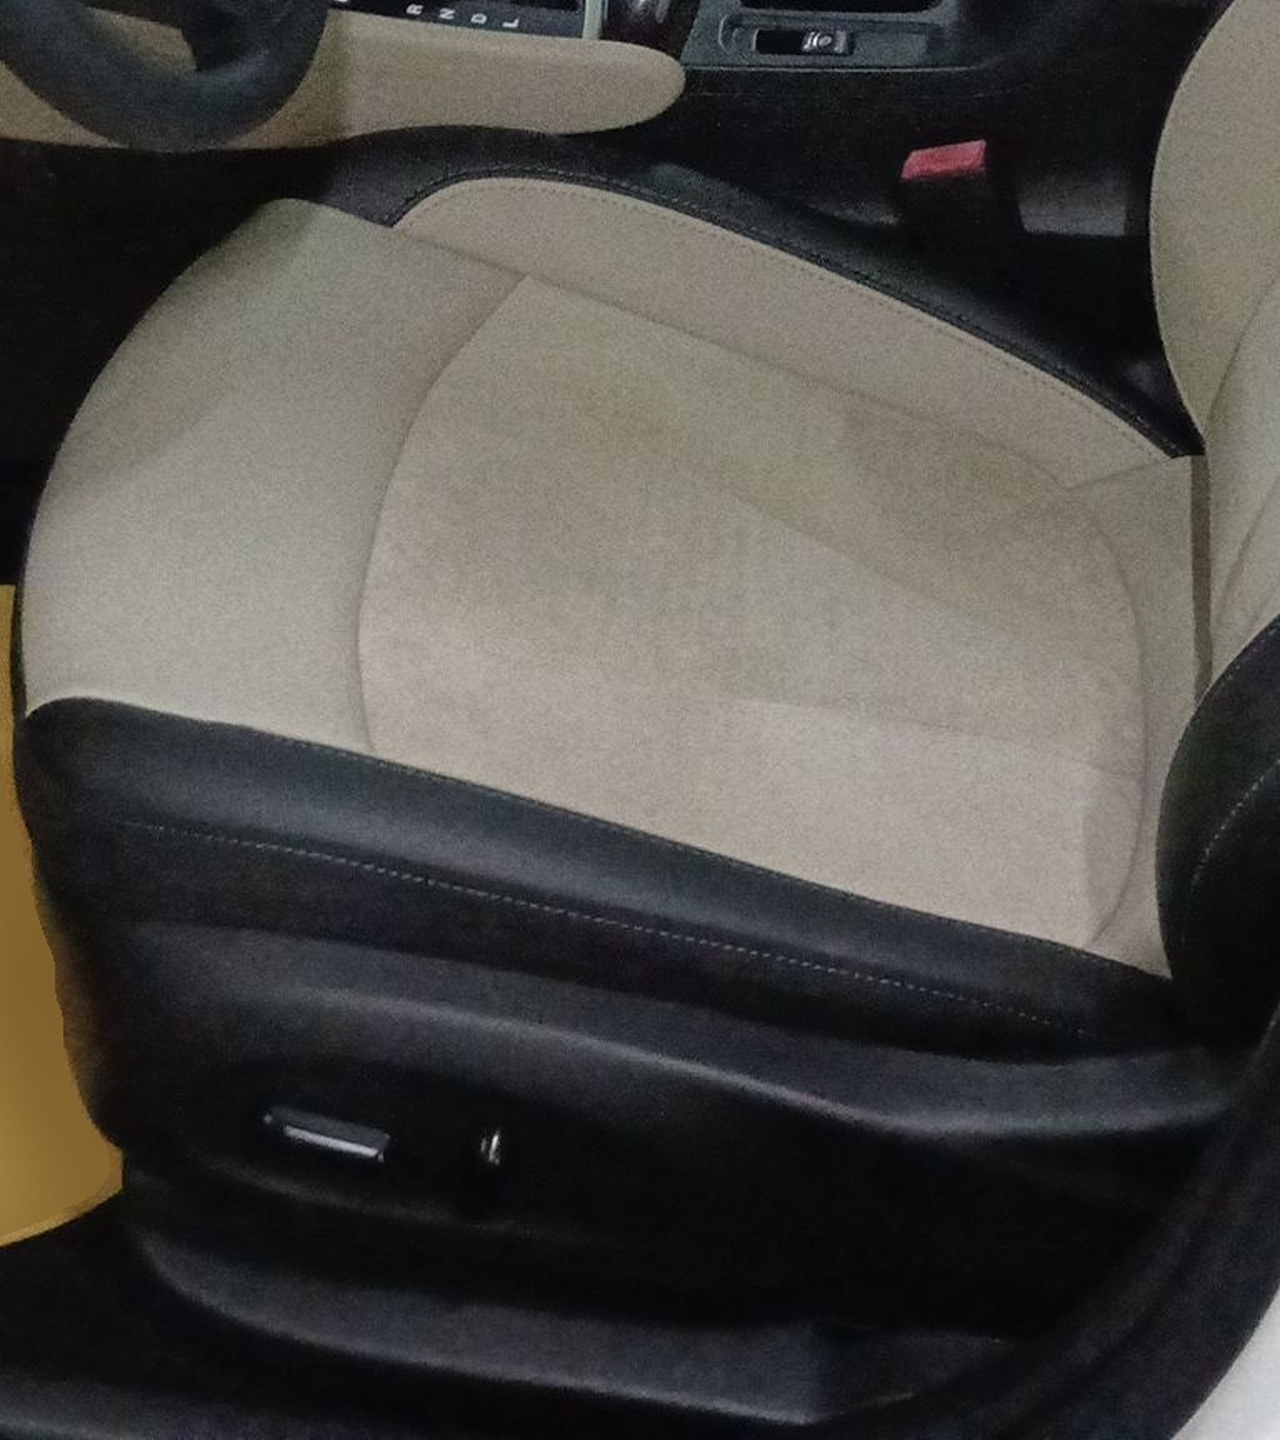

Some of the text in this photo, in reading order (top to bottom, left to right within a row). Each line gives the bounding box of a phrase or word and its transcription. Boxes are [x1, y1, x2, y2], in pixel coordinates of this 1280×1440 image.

[406, 4, 423, 15] R
[439, 8, 455, 20] N
[471, 13, 487, 24] D
[502, 18, 519, 28] L
